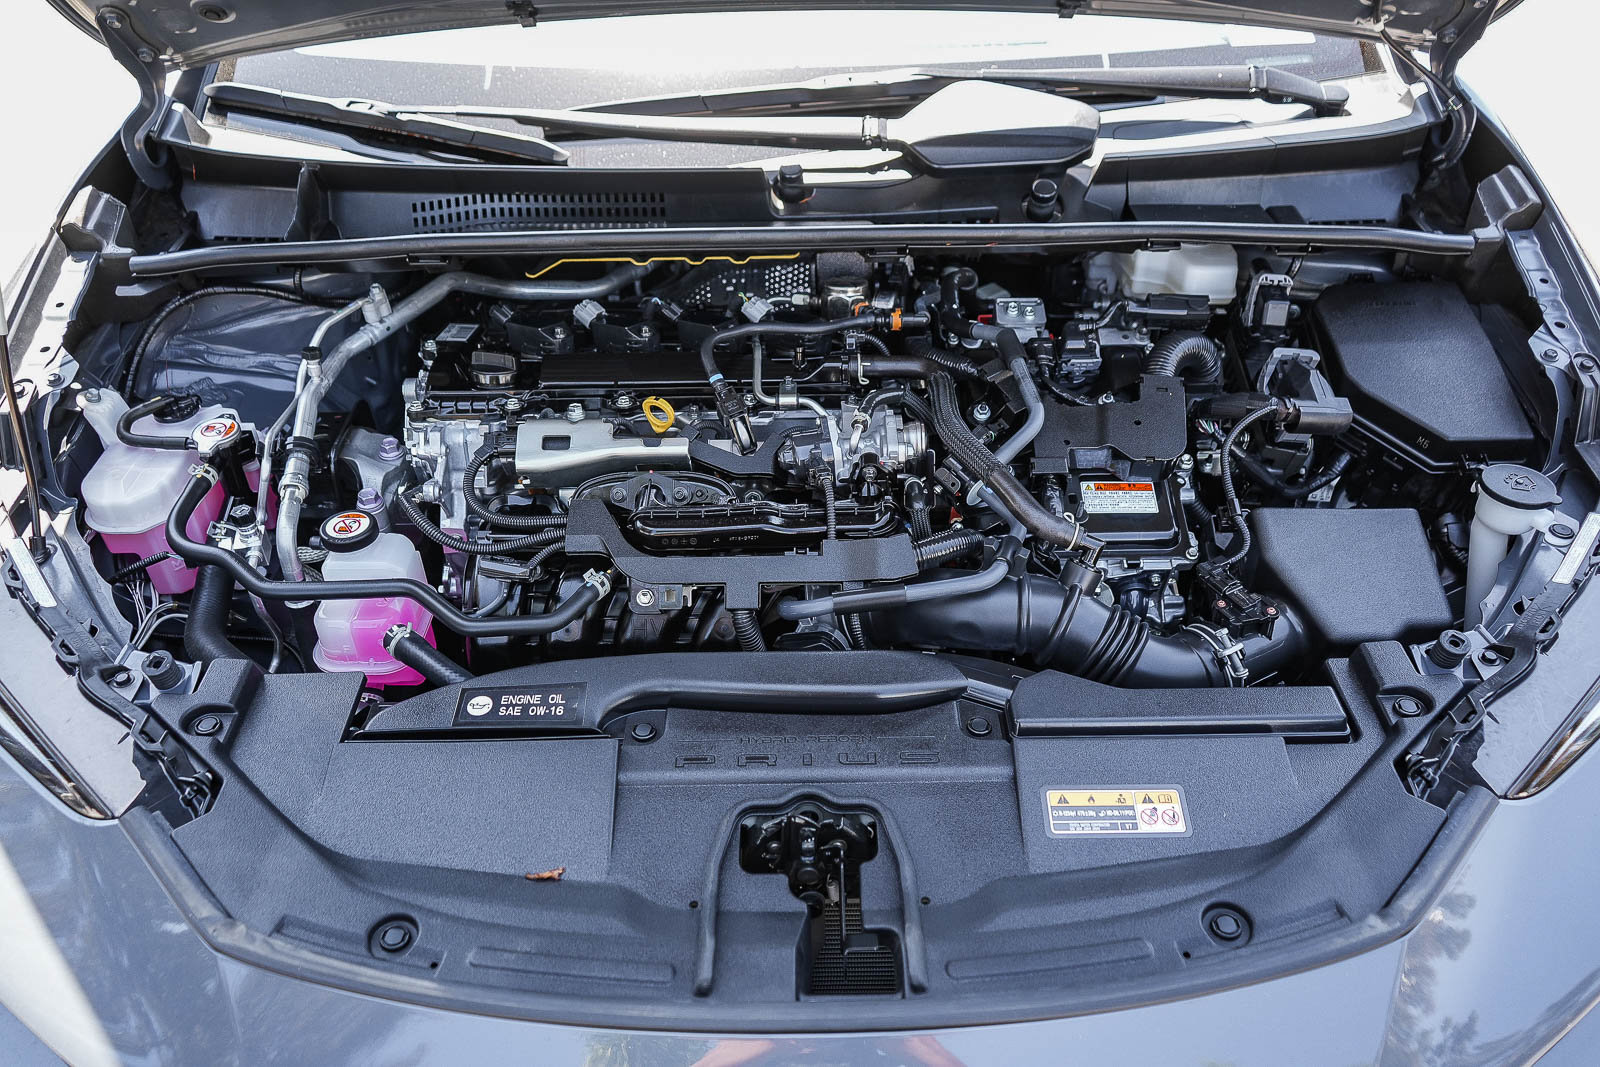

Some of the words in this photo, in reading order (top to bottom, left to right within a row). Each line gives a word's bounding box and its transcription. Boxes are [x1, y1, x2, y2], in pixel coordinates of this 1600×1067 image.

[500, 695, 542, 705] ENGINE
[548, 694, 566, 704] OIL
[498, 706, 523, 716] SAE
[528, 705, 565, 716] 0W-16
[740, 736, 797, 744] HYBRID
[806, 734, 873, 743] REBORN
[675, 751, 941, 768] PRIUS
